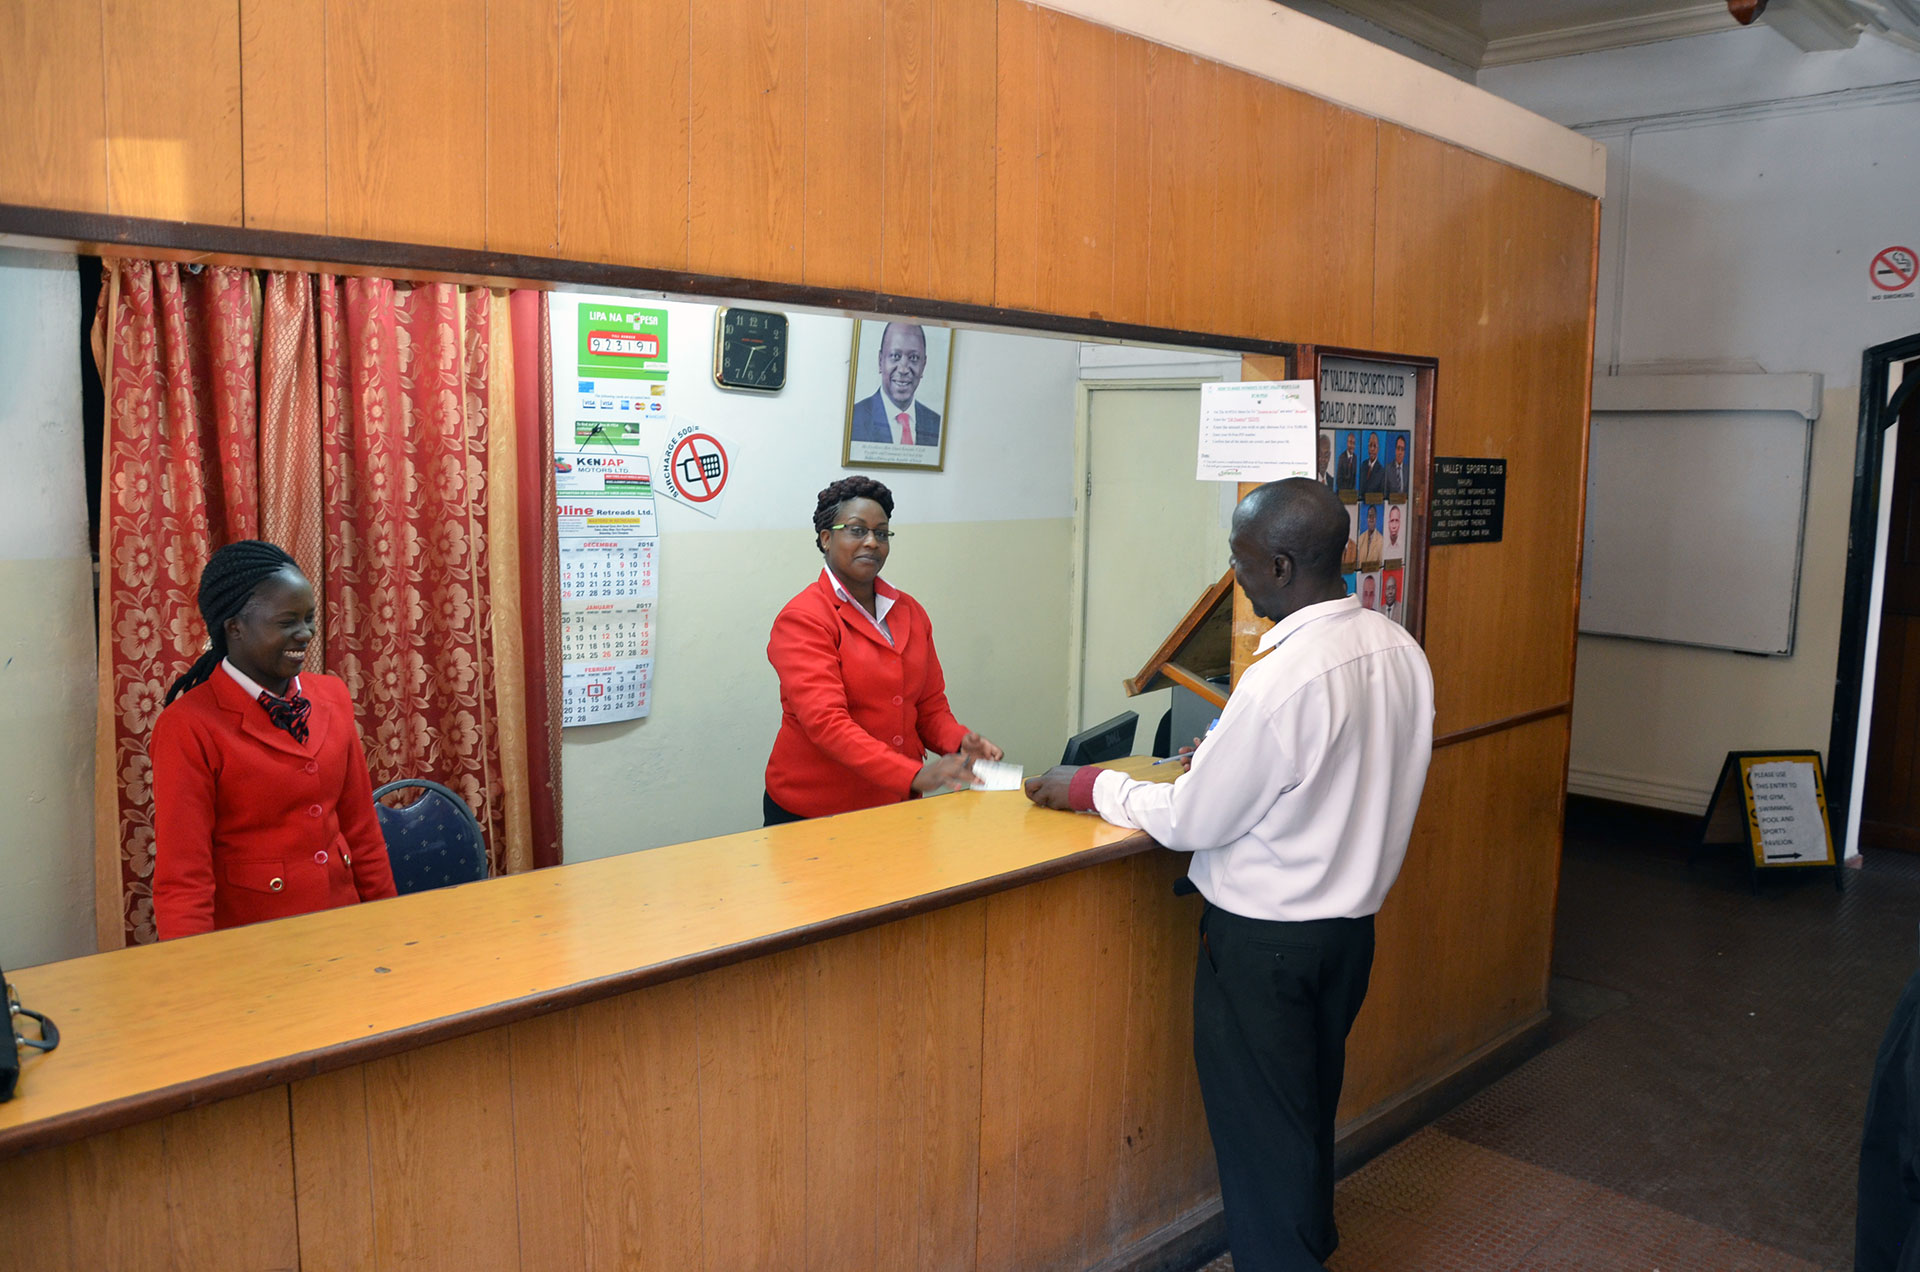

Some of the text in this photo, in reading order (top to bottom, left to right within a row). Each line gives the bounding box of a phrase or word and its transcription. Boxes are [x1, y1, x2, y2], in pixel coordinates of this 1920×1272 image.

[590, 311, 607, 321] LIPA
[609, 313, 622, 322] NA
[736, 315, 743, 326] 11
[749, 317, 758, 327] 12
[764, 320, 768, 329] 1
[726, 324, 733, 334] 10
[773, 330, 779, 339] 2
[725, 341, 730, 351] 9
[773, 347, 778, 357] 3
[725, 358, 730, 367] 8
[772, 363, 777, 373] 4
[736, 369, 740, 378] 7
[748, 371, 753, 380] 6
[1320, 369, 1404, 396] T VALLEY SPORTS CLUB
[1320, 401, 1396, 426] BOARD OF DIRECTORS
[664, 438, 679, 498] SURCHARGE
[1442, 464, 1463, 474] VALLEY
[1466, 464, 1487, 474] SPORTS
[1490, 465, 1503, 474] CLUB
